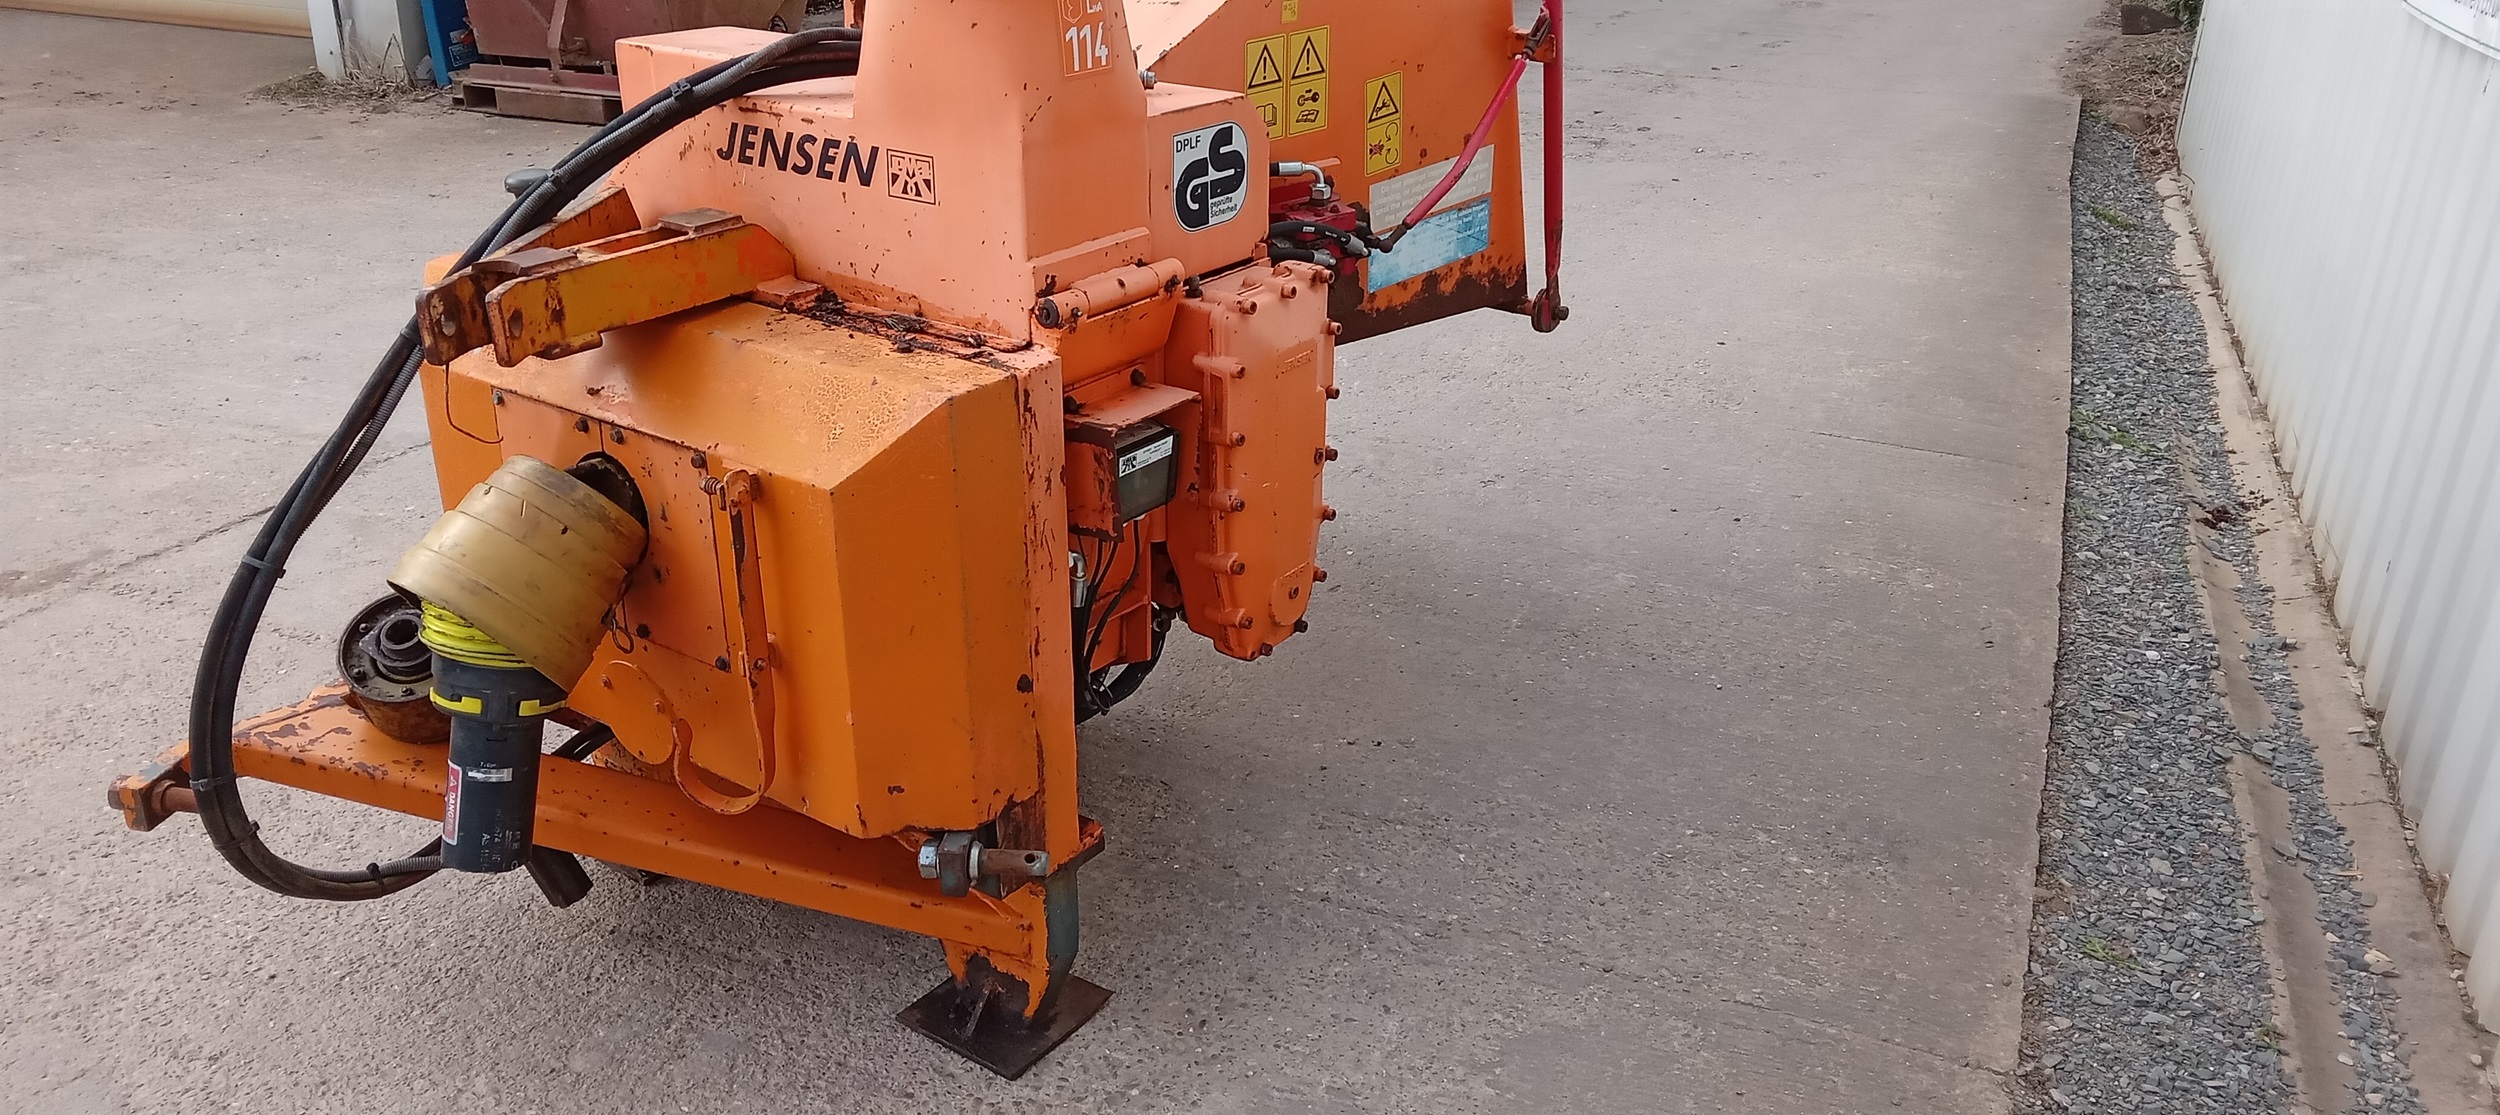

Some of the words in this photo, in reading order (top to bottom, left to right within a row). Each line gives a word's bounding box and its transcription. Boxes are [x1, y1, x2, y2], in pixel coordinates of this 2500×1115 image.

[1065, 21, 1109, 72] 114
[716, 121, 880, 187] JENSEN
[1176, 135, 1202, 153] DPLF
[1175, 125, 1246, 229] GS
[1210, 203, 1238, 218] Sicherheit
